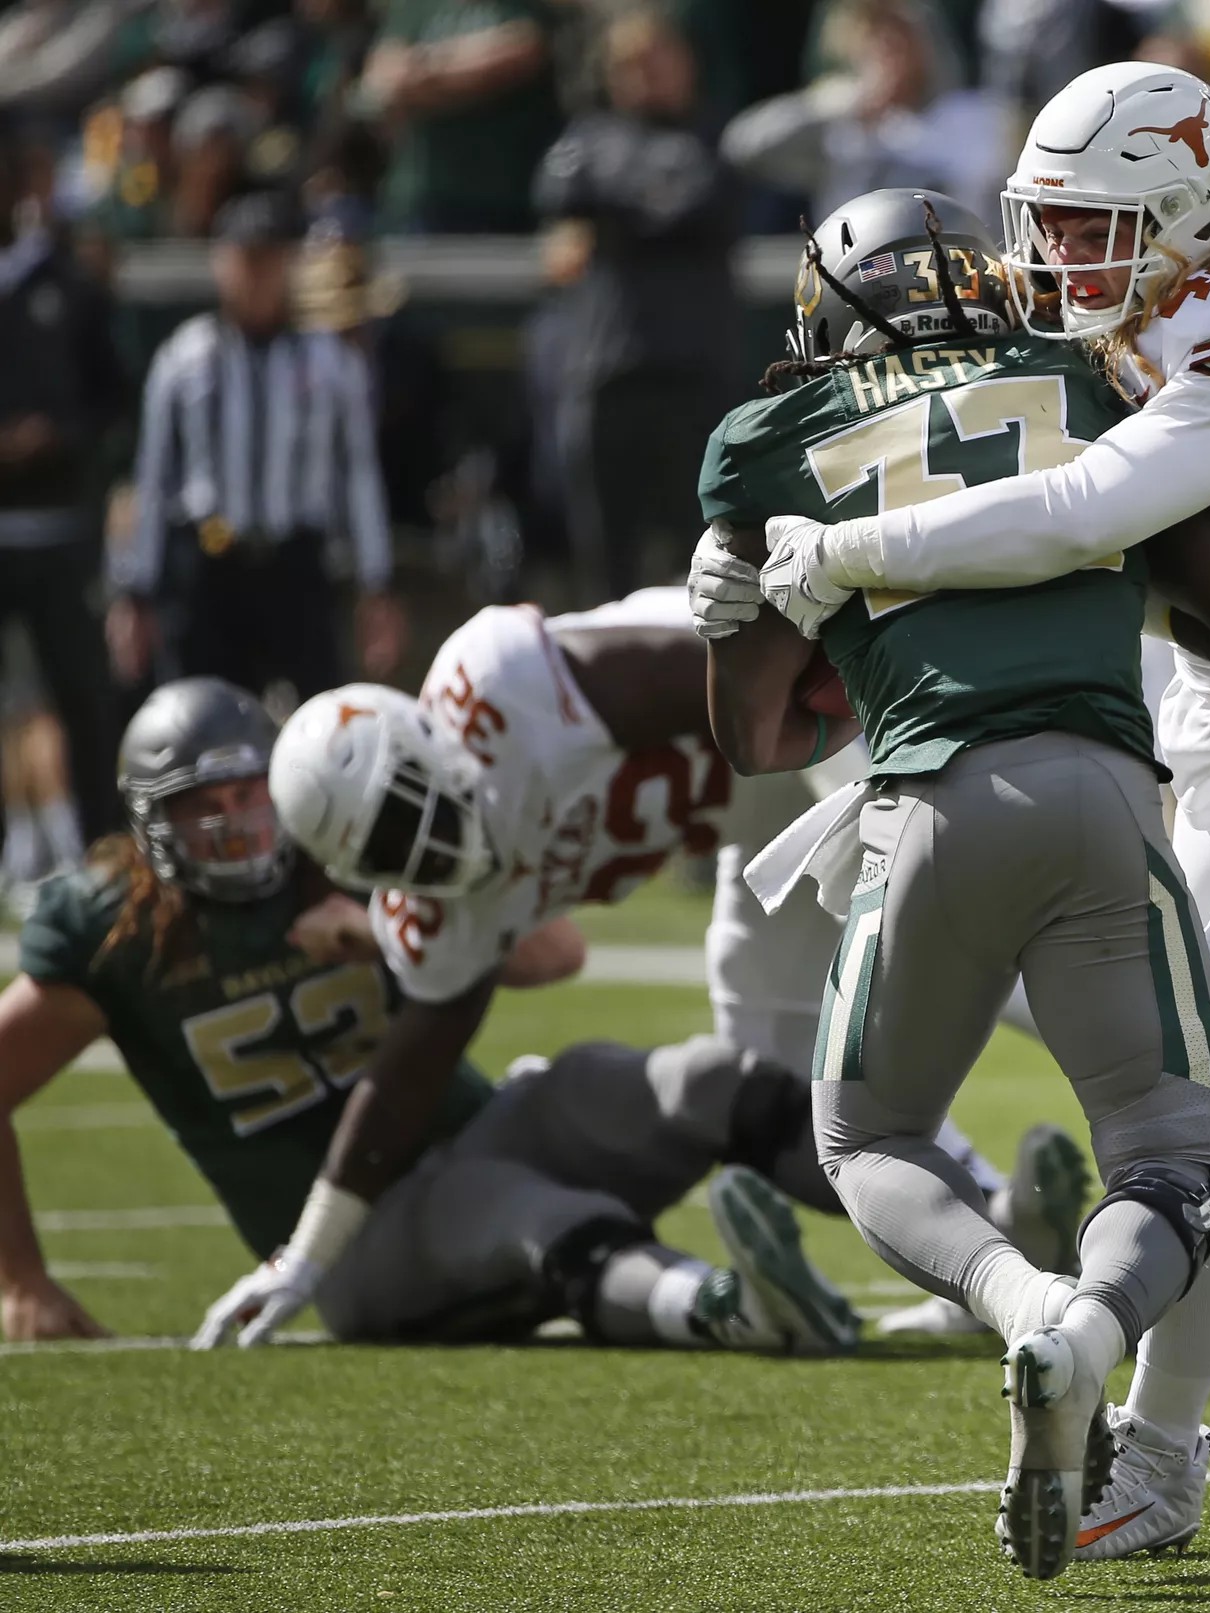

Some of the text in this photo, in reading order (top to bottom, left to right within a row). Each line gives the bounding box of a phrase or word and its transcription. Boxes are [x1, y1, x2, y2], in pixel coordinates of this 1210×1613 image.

[903, 249, 981, 303] 33
[917, 314, 988, 331] Ridell
[849, 347, 997, 414] HASTY
